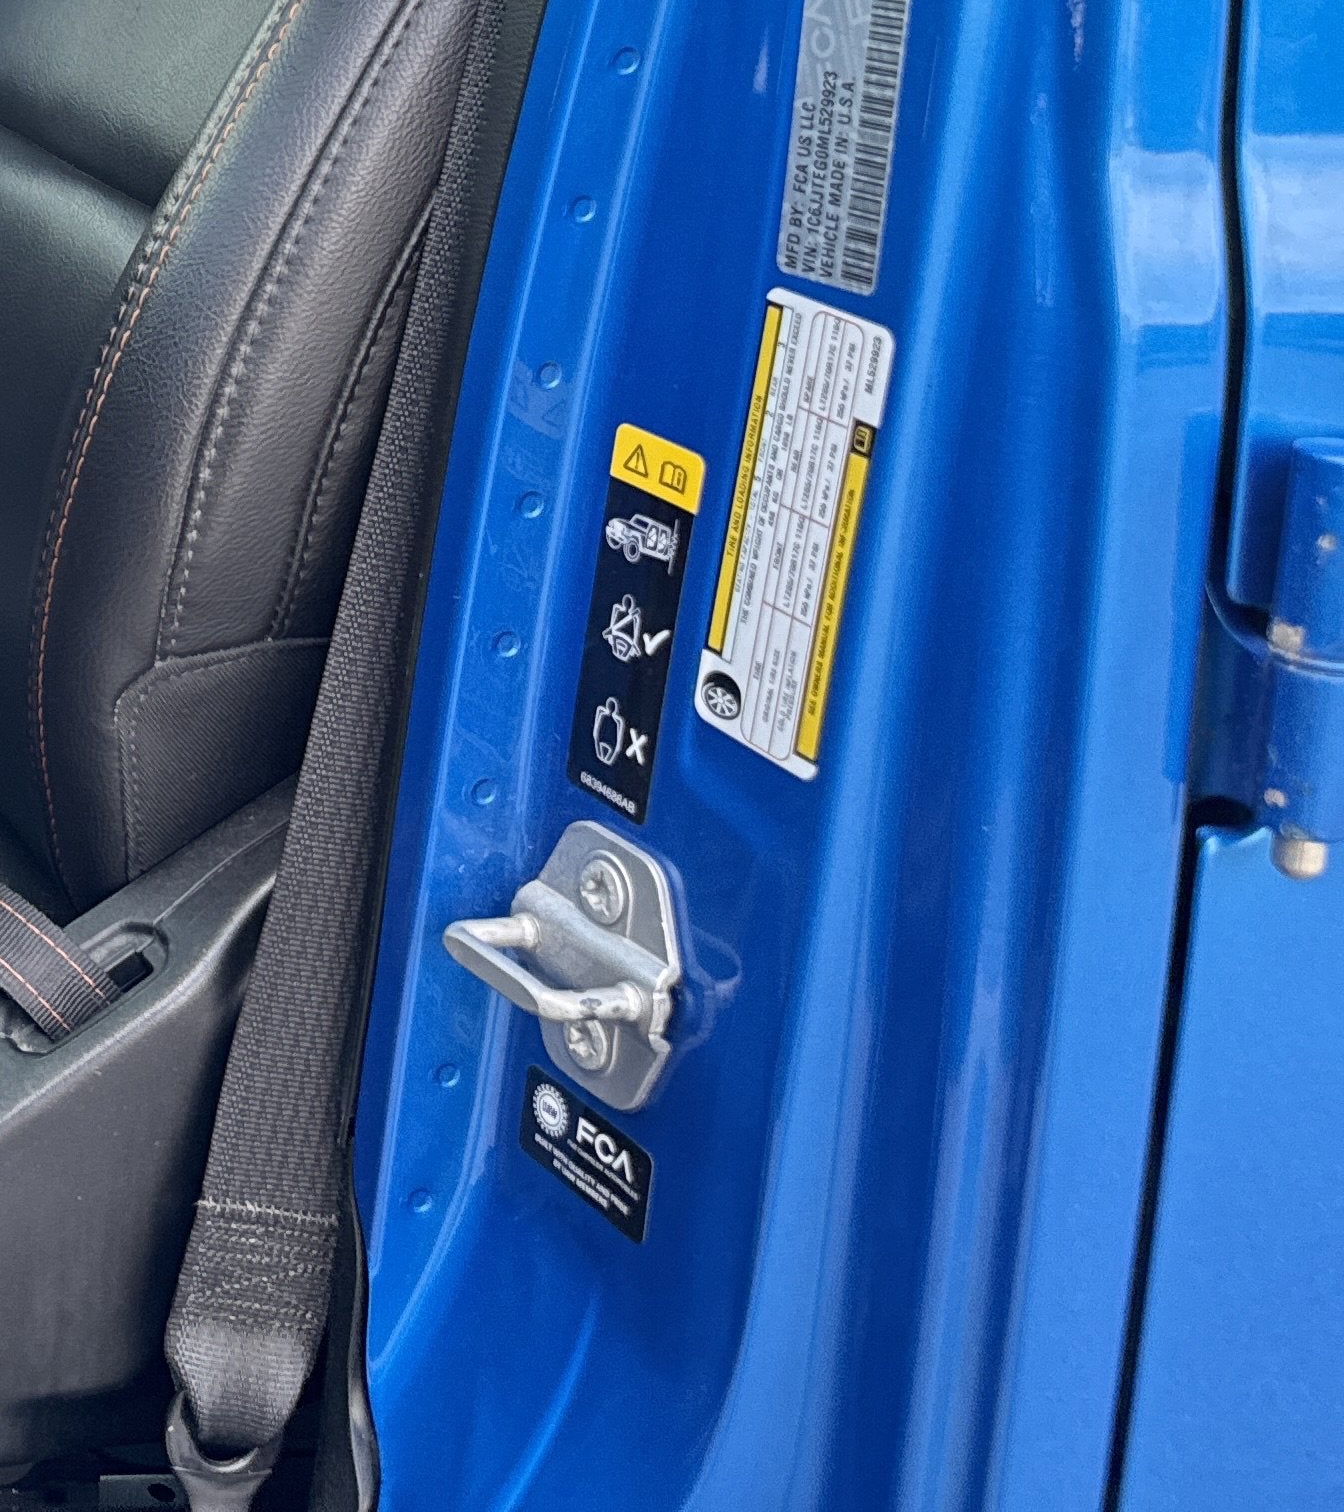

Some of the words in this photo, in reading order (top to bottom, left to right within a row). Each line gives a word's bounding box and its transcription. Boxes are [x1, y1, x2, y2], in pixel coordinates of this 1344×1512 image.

[799, 101, 814, 130] LLC
[796, 135, 810, 157] US
[807, 69, 836, 235] 1C6JJTEG0ML529923
[793, 162, 808, 194] FCA
[828, 159, 845, 207] MADE
[789, 201, 804, 228] BY:
[785, 232, 800, 269] MFD
[803, 240, 818, 274] VIN:
[821, 212, 840, 280] VEHICLE
[743, 393, 762, 464] INFORMATION
[735, 464, 749, 510] LOADING
[731, 510, 741, 533] AND
[726, 533, 737, 558] TIRE
[576, 1115, 636, 1185] FCA
